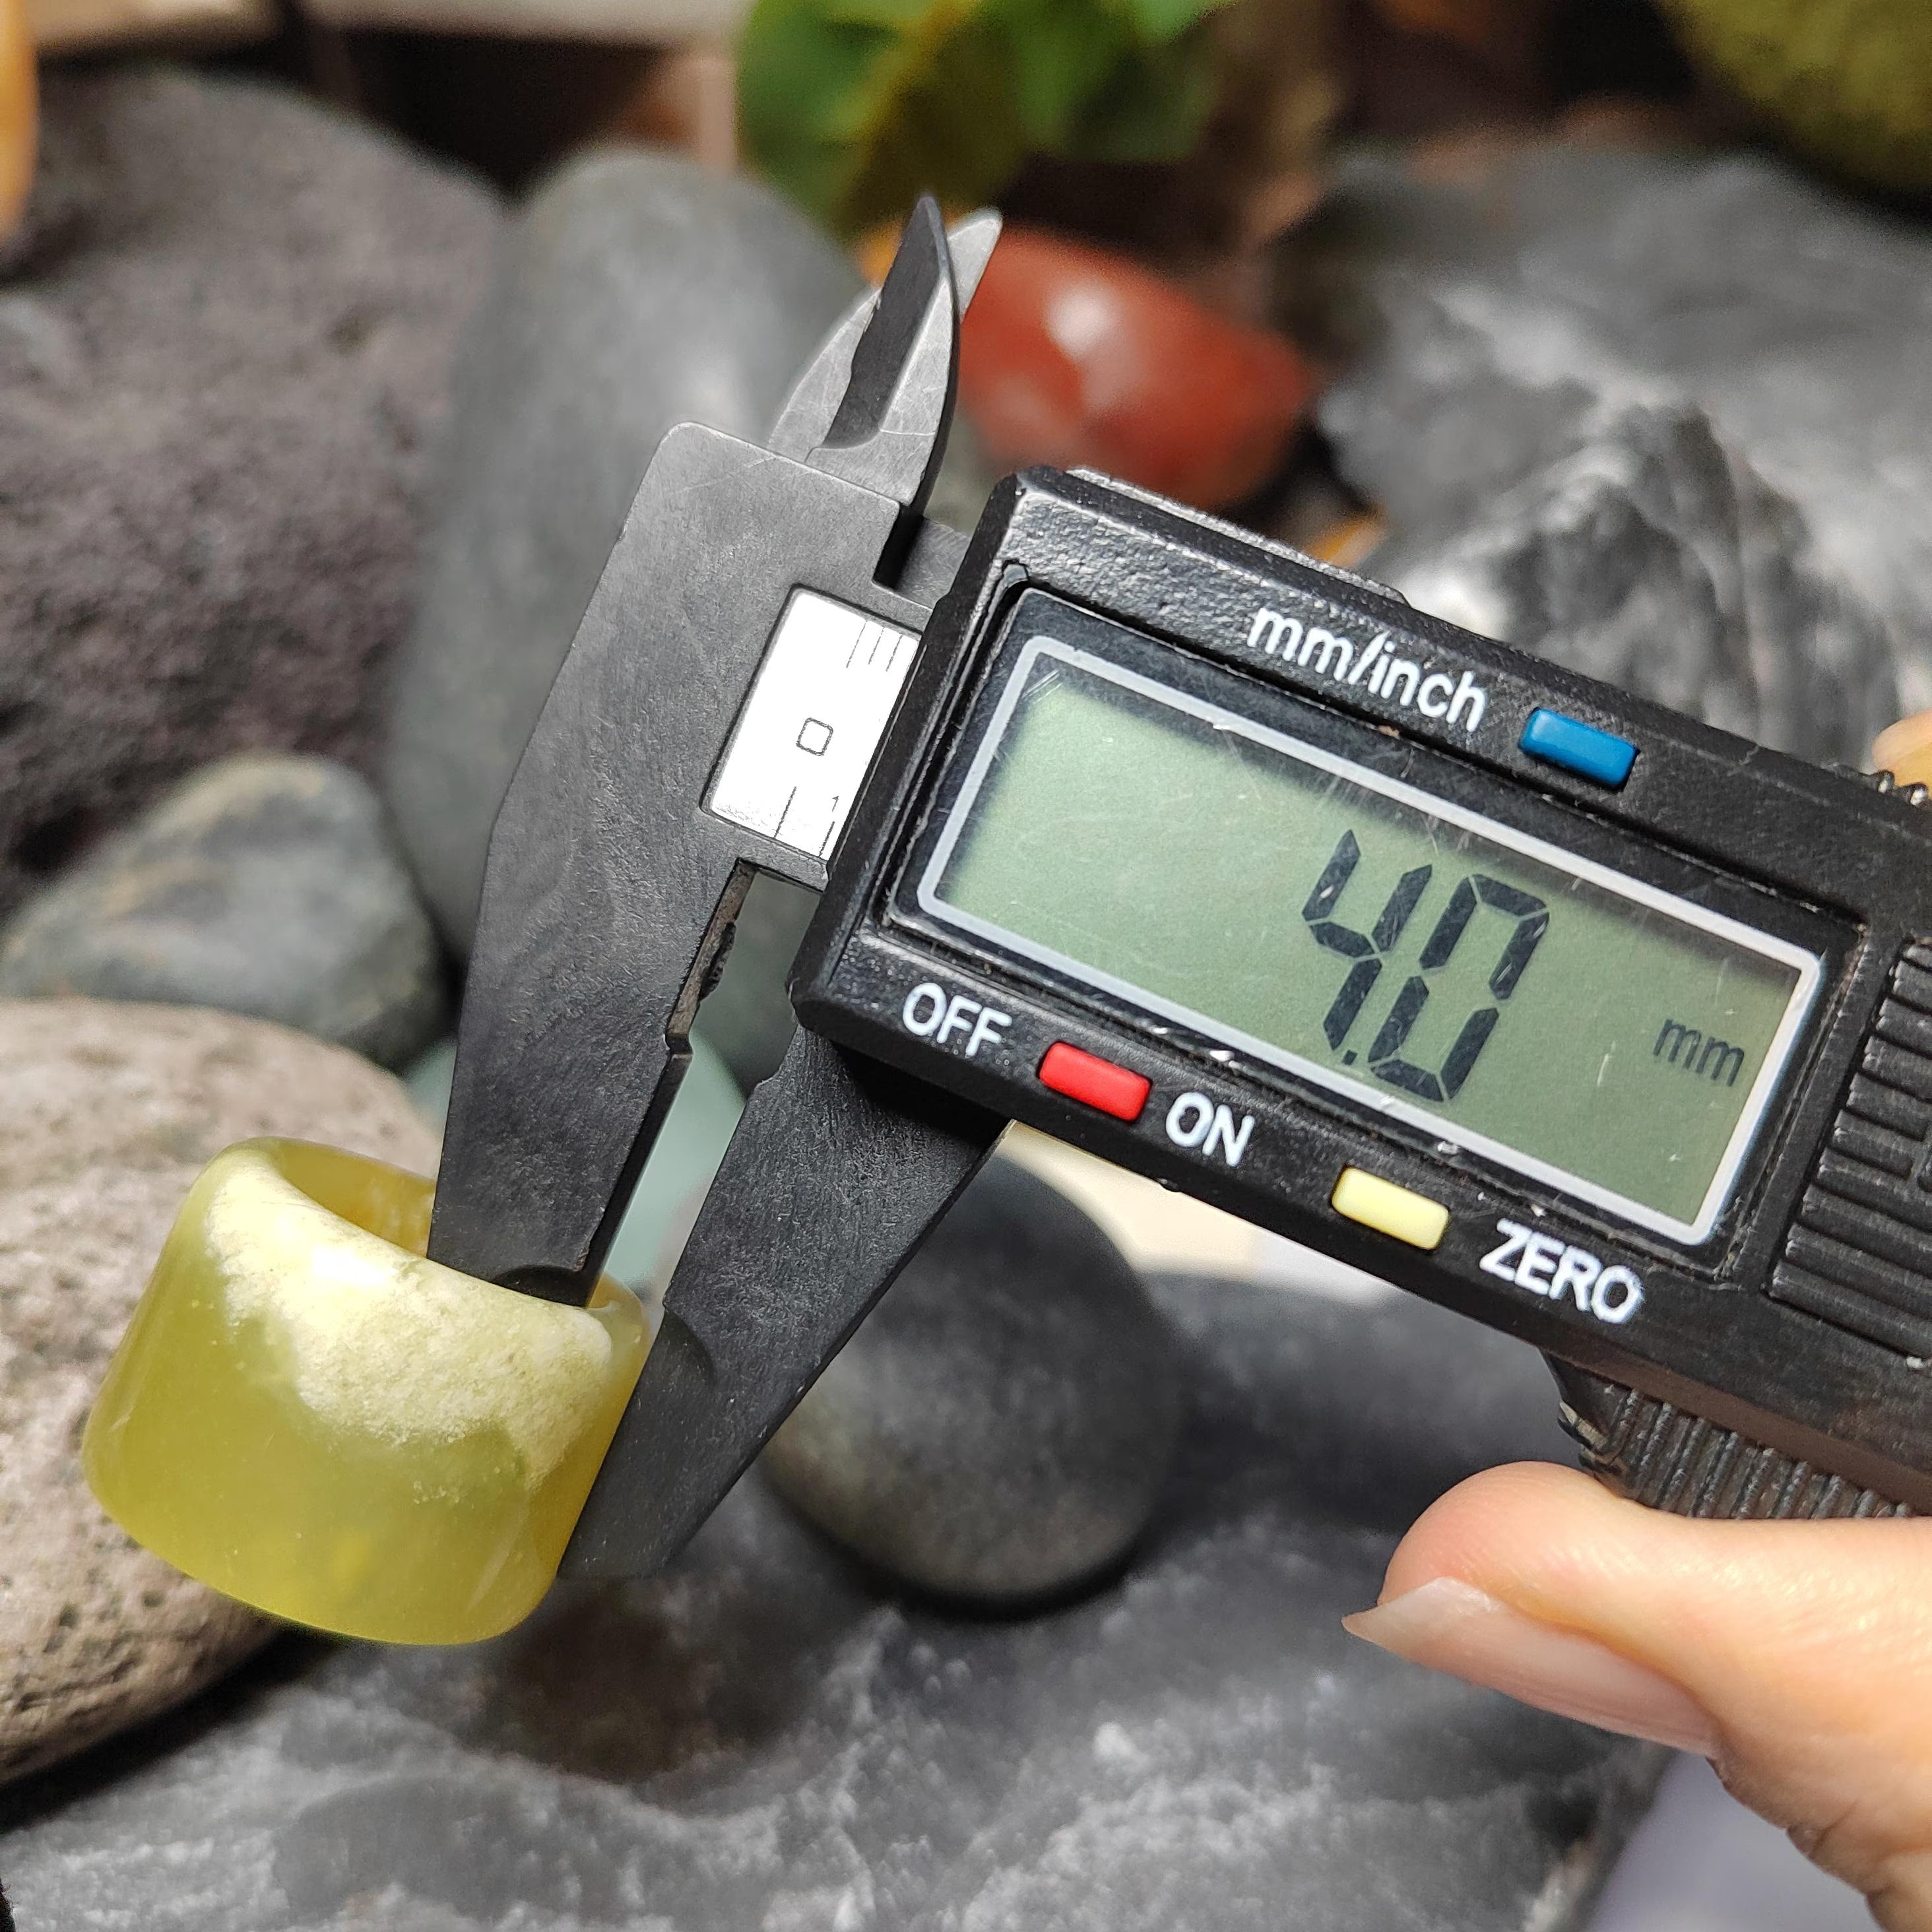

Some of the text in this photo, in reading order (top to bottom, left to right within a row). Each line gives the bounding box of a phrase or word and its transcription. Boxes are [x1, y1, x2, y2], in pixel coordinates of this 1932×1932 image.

[1247, 608, 1487, 732] mm/inch
[1301, 829, 1745, 1103] 4.0 mm
[902, 982, 1013, 1057] OFF
[1165, 1092, 1256, 1167] ON
[1479, 1218, 1646, 1324] ZERO
